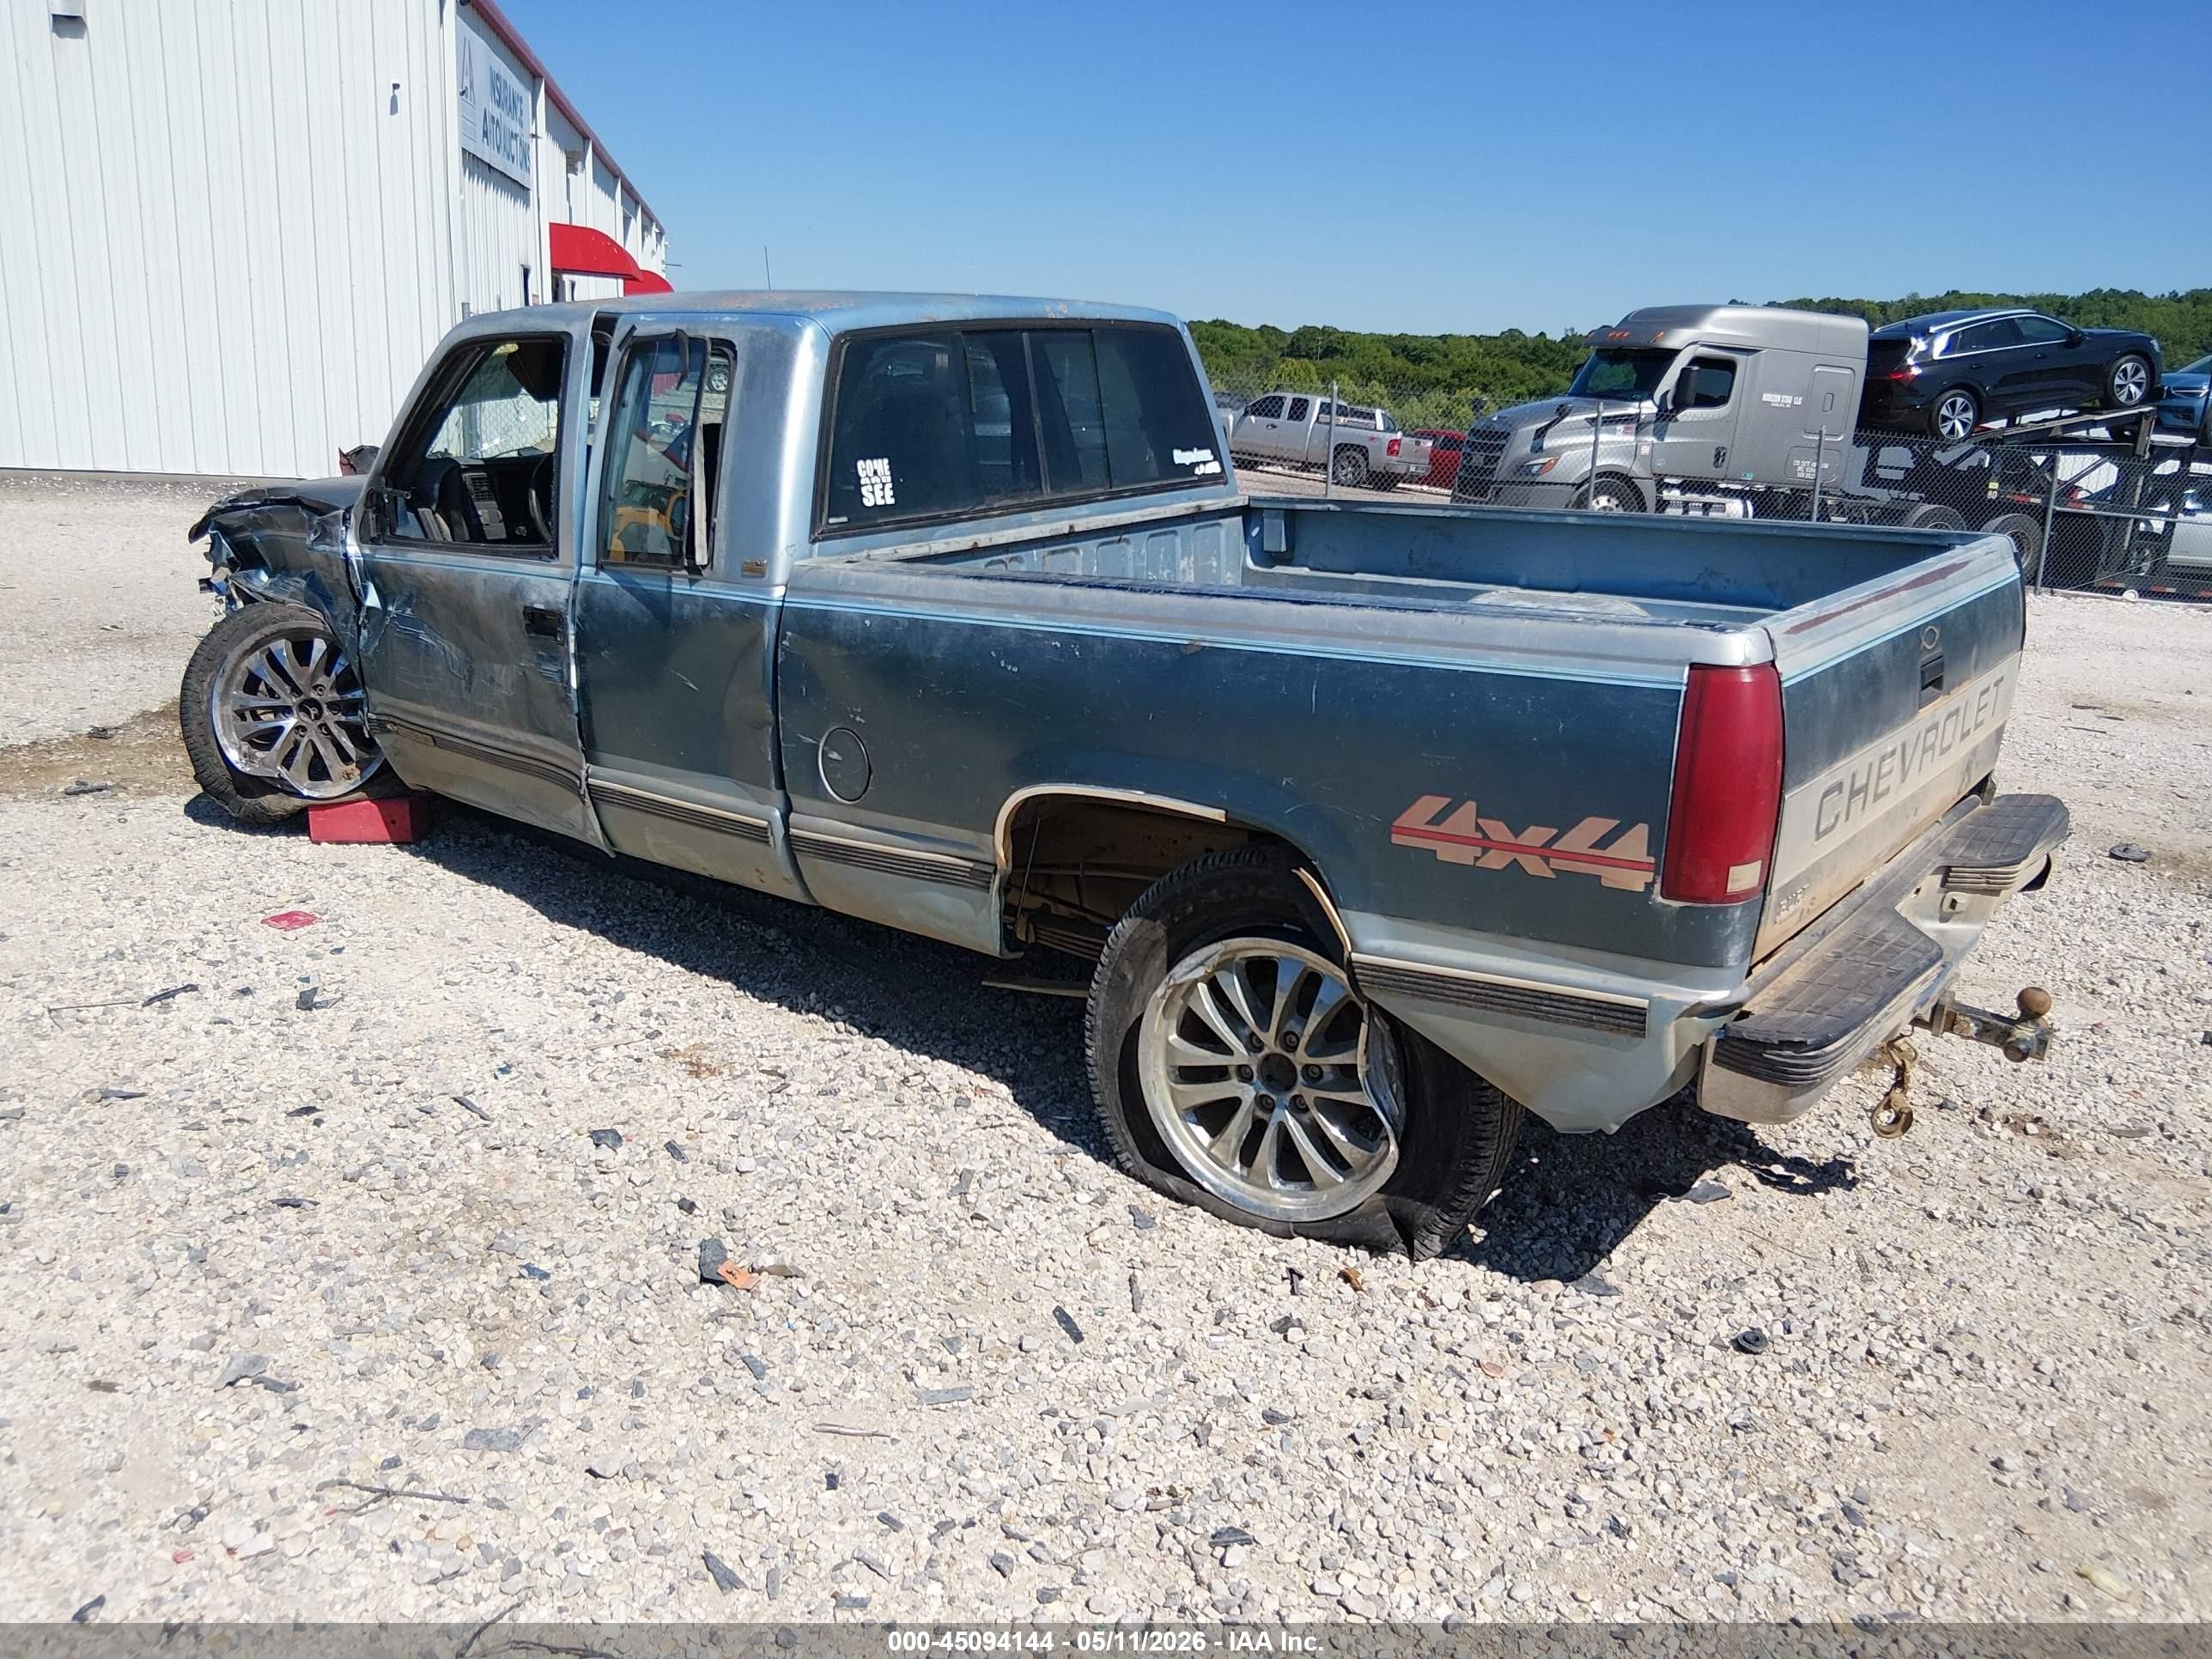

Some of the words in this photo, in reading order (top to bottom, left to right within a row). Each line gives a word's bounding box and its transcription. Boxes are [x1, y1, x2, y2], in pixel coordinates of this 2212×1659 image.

[501, 126, 531, 175] AUCTONS
[857, 458, 890, 477] COME
[860, 483, 895, 507] SEE
[1814, 675, 2004, 842] CHEVROLET
